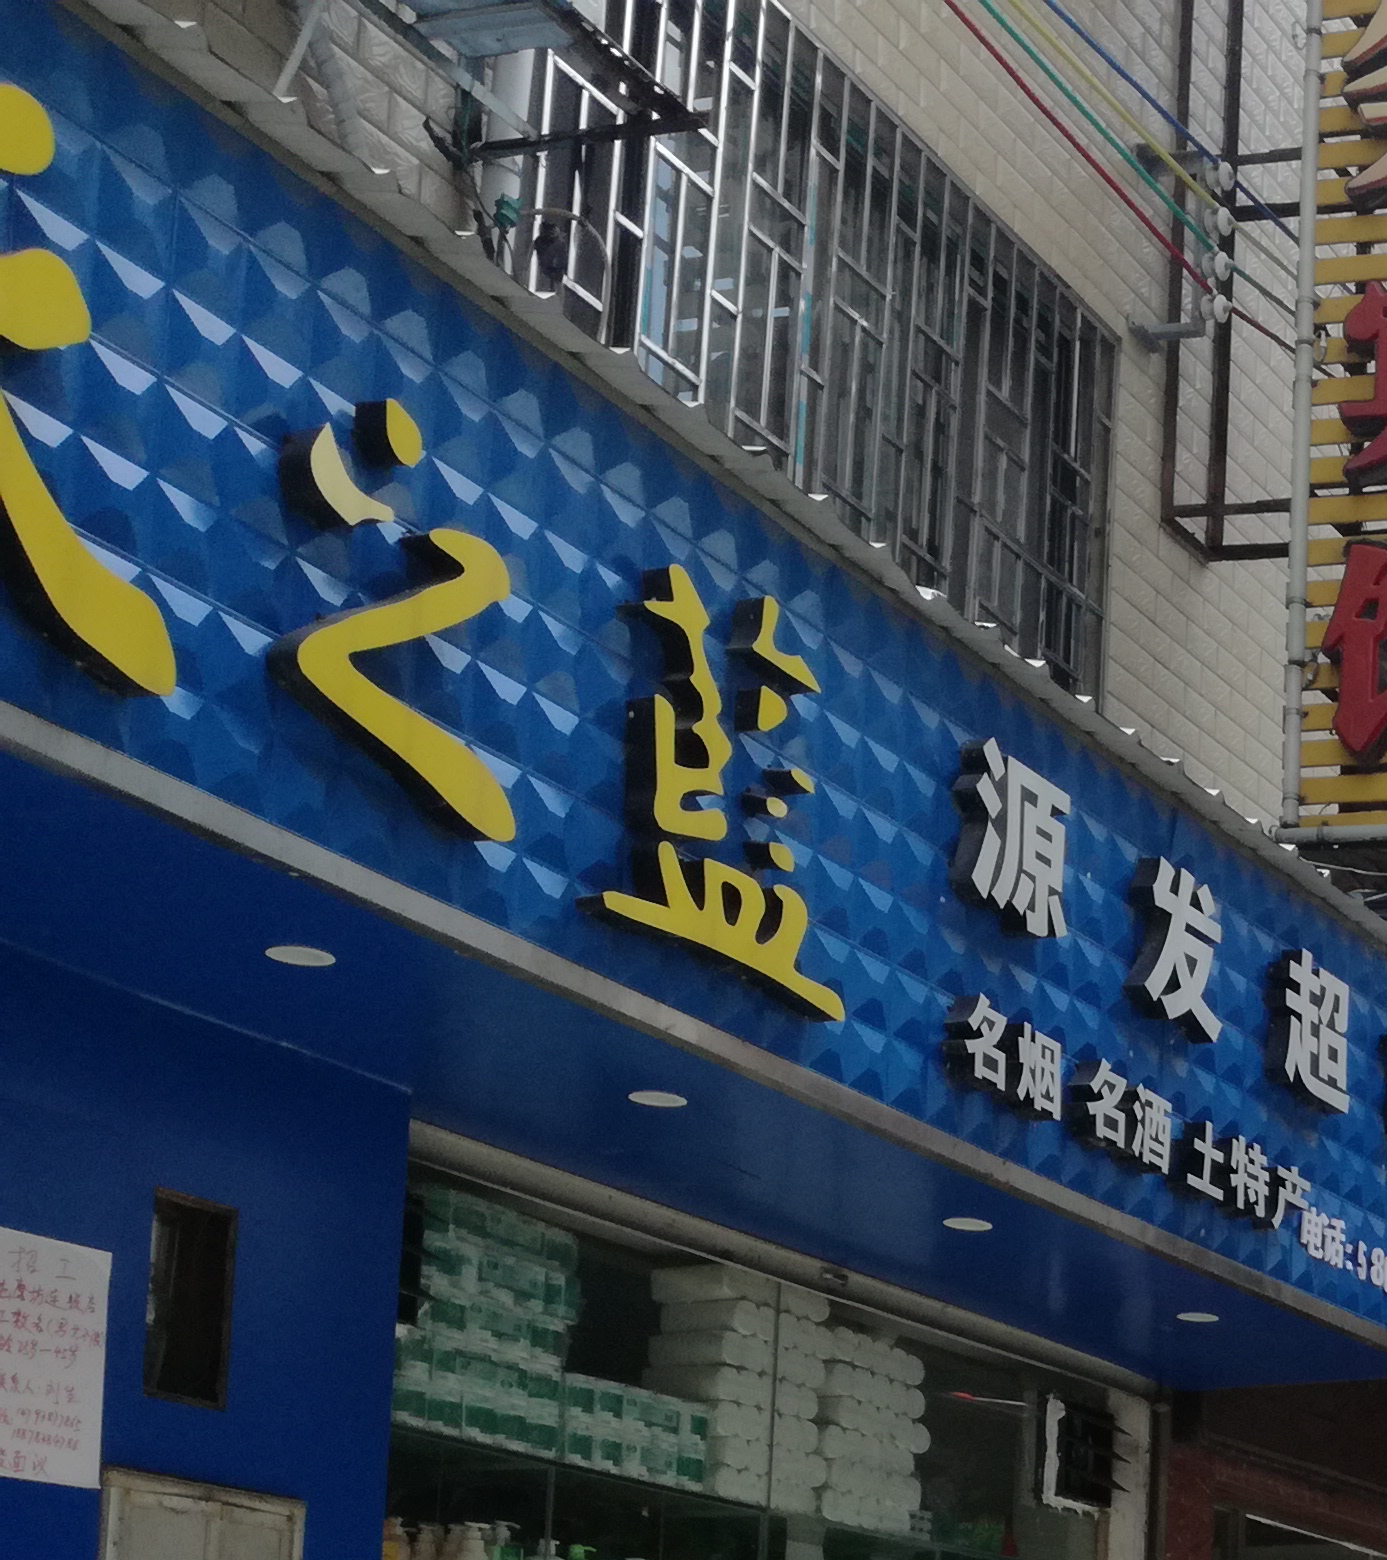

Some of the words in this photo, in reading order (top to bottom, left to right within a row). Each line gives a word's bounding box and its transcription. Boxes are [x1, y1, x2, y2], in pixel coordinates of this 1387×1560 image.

[964, 993, 1062, 1121] 名烟
[1087, 1058, 1171, 1174] 名酒
[1186, 1121, 1312, 1230] 土特产
